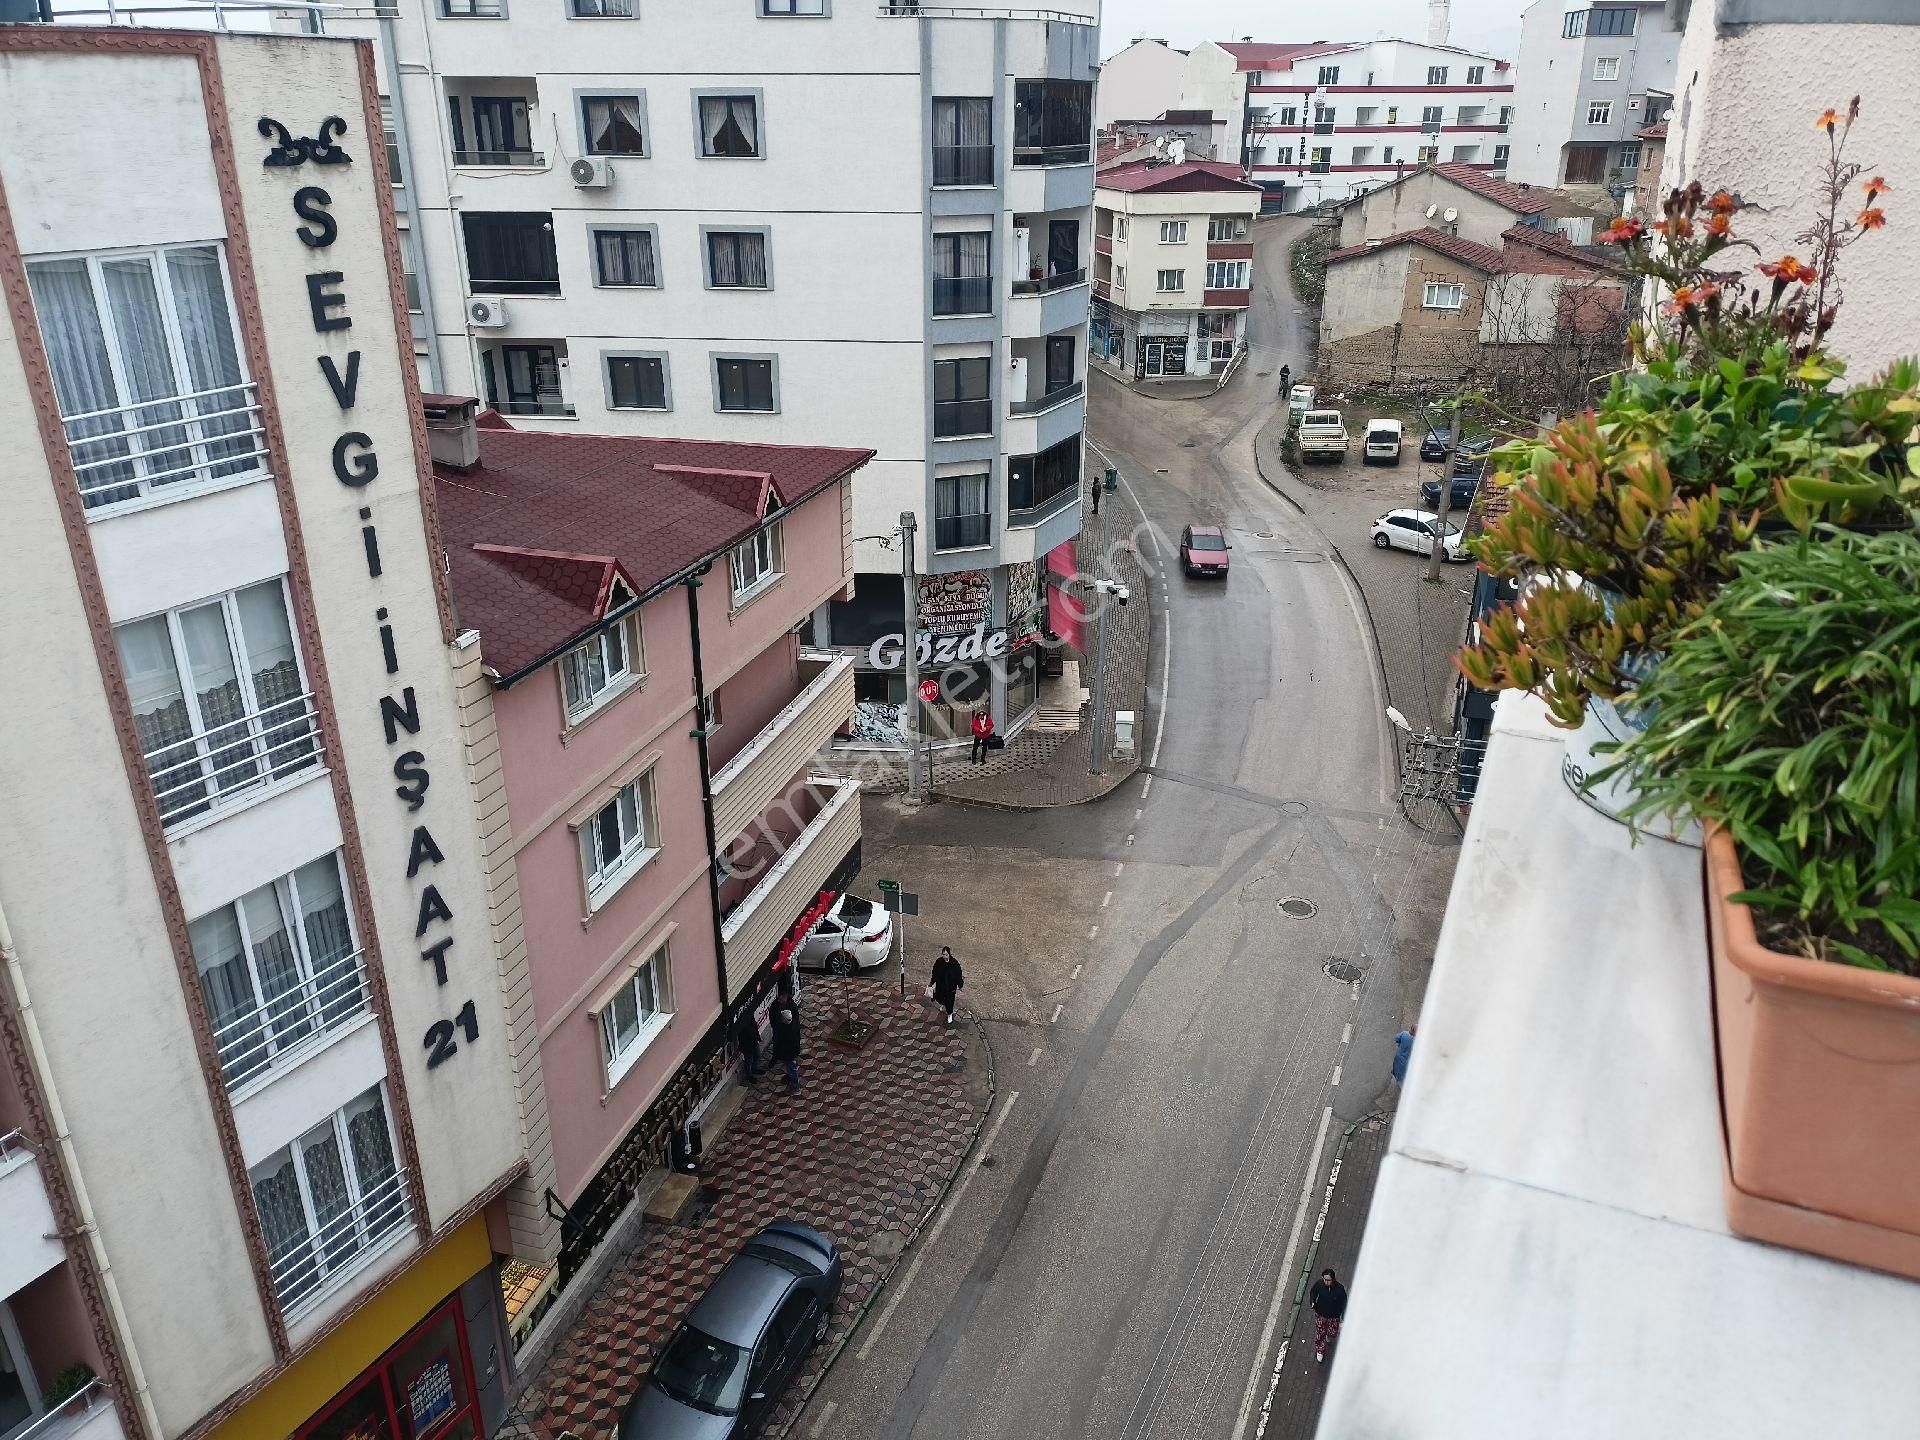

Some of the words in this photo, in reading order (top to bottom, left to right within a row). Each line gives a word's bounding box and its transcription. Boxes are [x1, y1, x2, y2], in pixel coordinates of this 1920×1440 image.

[293, 186, 382, 577] SEVGİ
[376, 607, 454, 988] İNŞAAT
[424, 999, 478, 1069] 21
[869, 622, 1008, 670] Gözde
[920, 685, 937, 697] DUR
